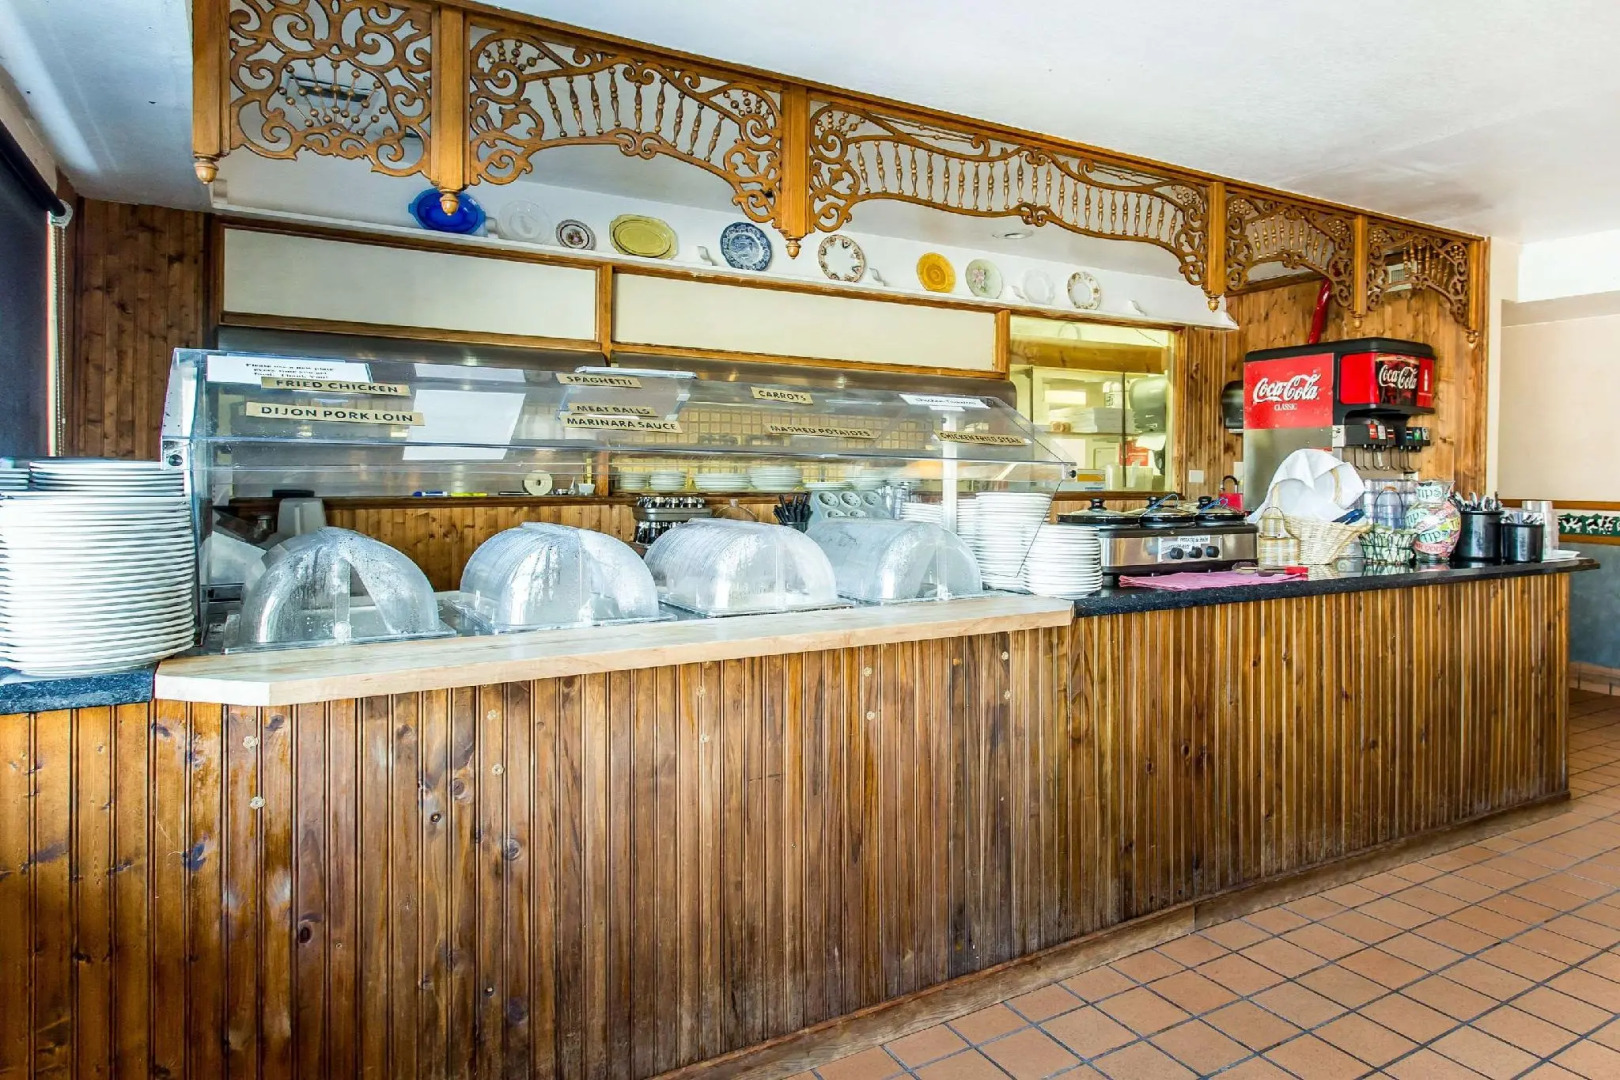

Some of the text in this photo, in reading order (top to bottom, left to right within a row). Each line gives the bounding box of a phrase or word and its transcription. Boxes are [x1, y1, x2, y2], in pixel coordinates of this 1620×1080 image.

[566, 376, 632, 385] SPAGHETTI
[1378, 364, 1418, 389] Coca-Cola
[276, 380, 398, 392] FRIED CHICKEN
[1253, 373, 1321, 404] Coca-Cola
[758, 390, 806, 402] CARROTS
[613, 406, 650, 414] BALLS
[1274, 403, 1298, 411] CLASSIC
[261, 406, 414, 422] DIJON PORK LOIN
[567, 418, 677, 430] MARINARA SAUCE
[770, 425, 870, 436] MASHED POTATOES
[940, 432, 975, 441] CHICKEN
